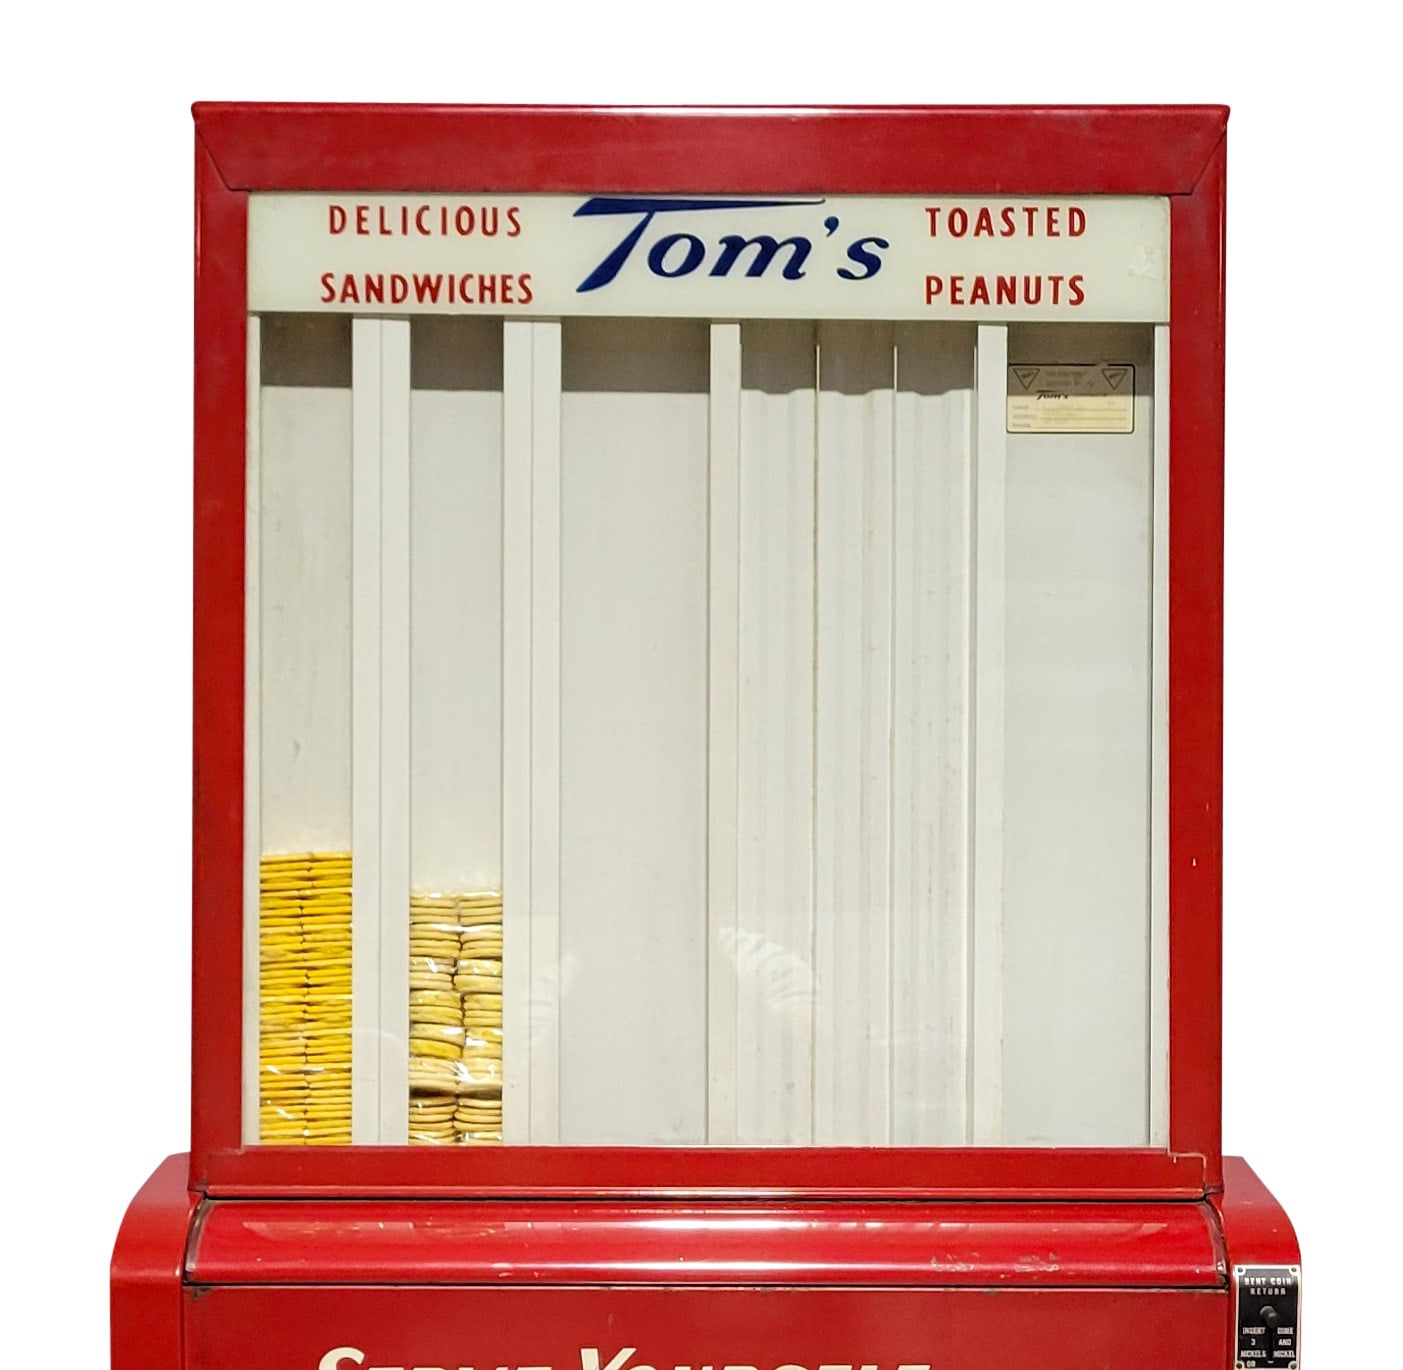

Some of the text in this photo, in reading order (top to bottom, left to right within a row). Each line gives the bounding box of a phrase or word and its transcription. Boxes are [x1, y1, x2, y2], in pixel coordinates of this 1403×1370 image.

[328, 205, 522, 236] DELICIOUS
[926, 207, 1088, 238] TOASTED
[573, 197, 889, 293] Tom's
[321, 272, 534, 305] SANDWICHES
[926, 275, 1086, 306] PEANUTS
[1250, 1287, 1286, 1295] RETURN
[1270, 1277, 1292, 1286] COIN
[1278, 1338, 1292, 1346] AND
[1240, 1350, 1267, 1358] NICKELS
[1273, 1350, 1295, 1358] NICKEL
